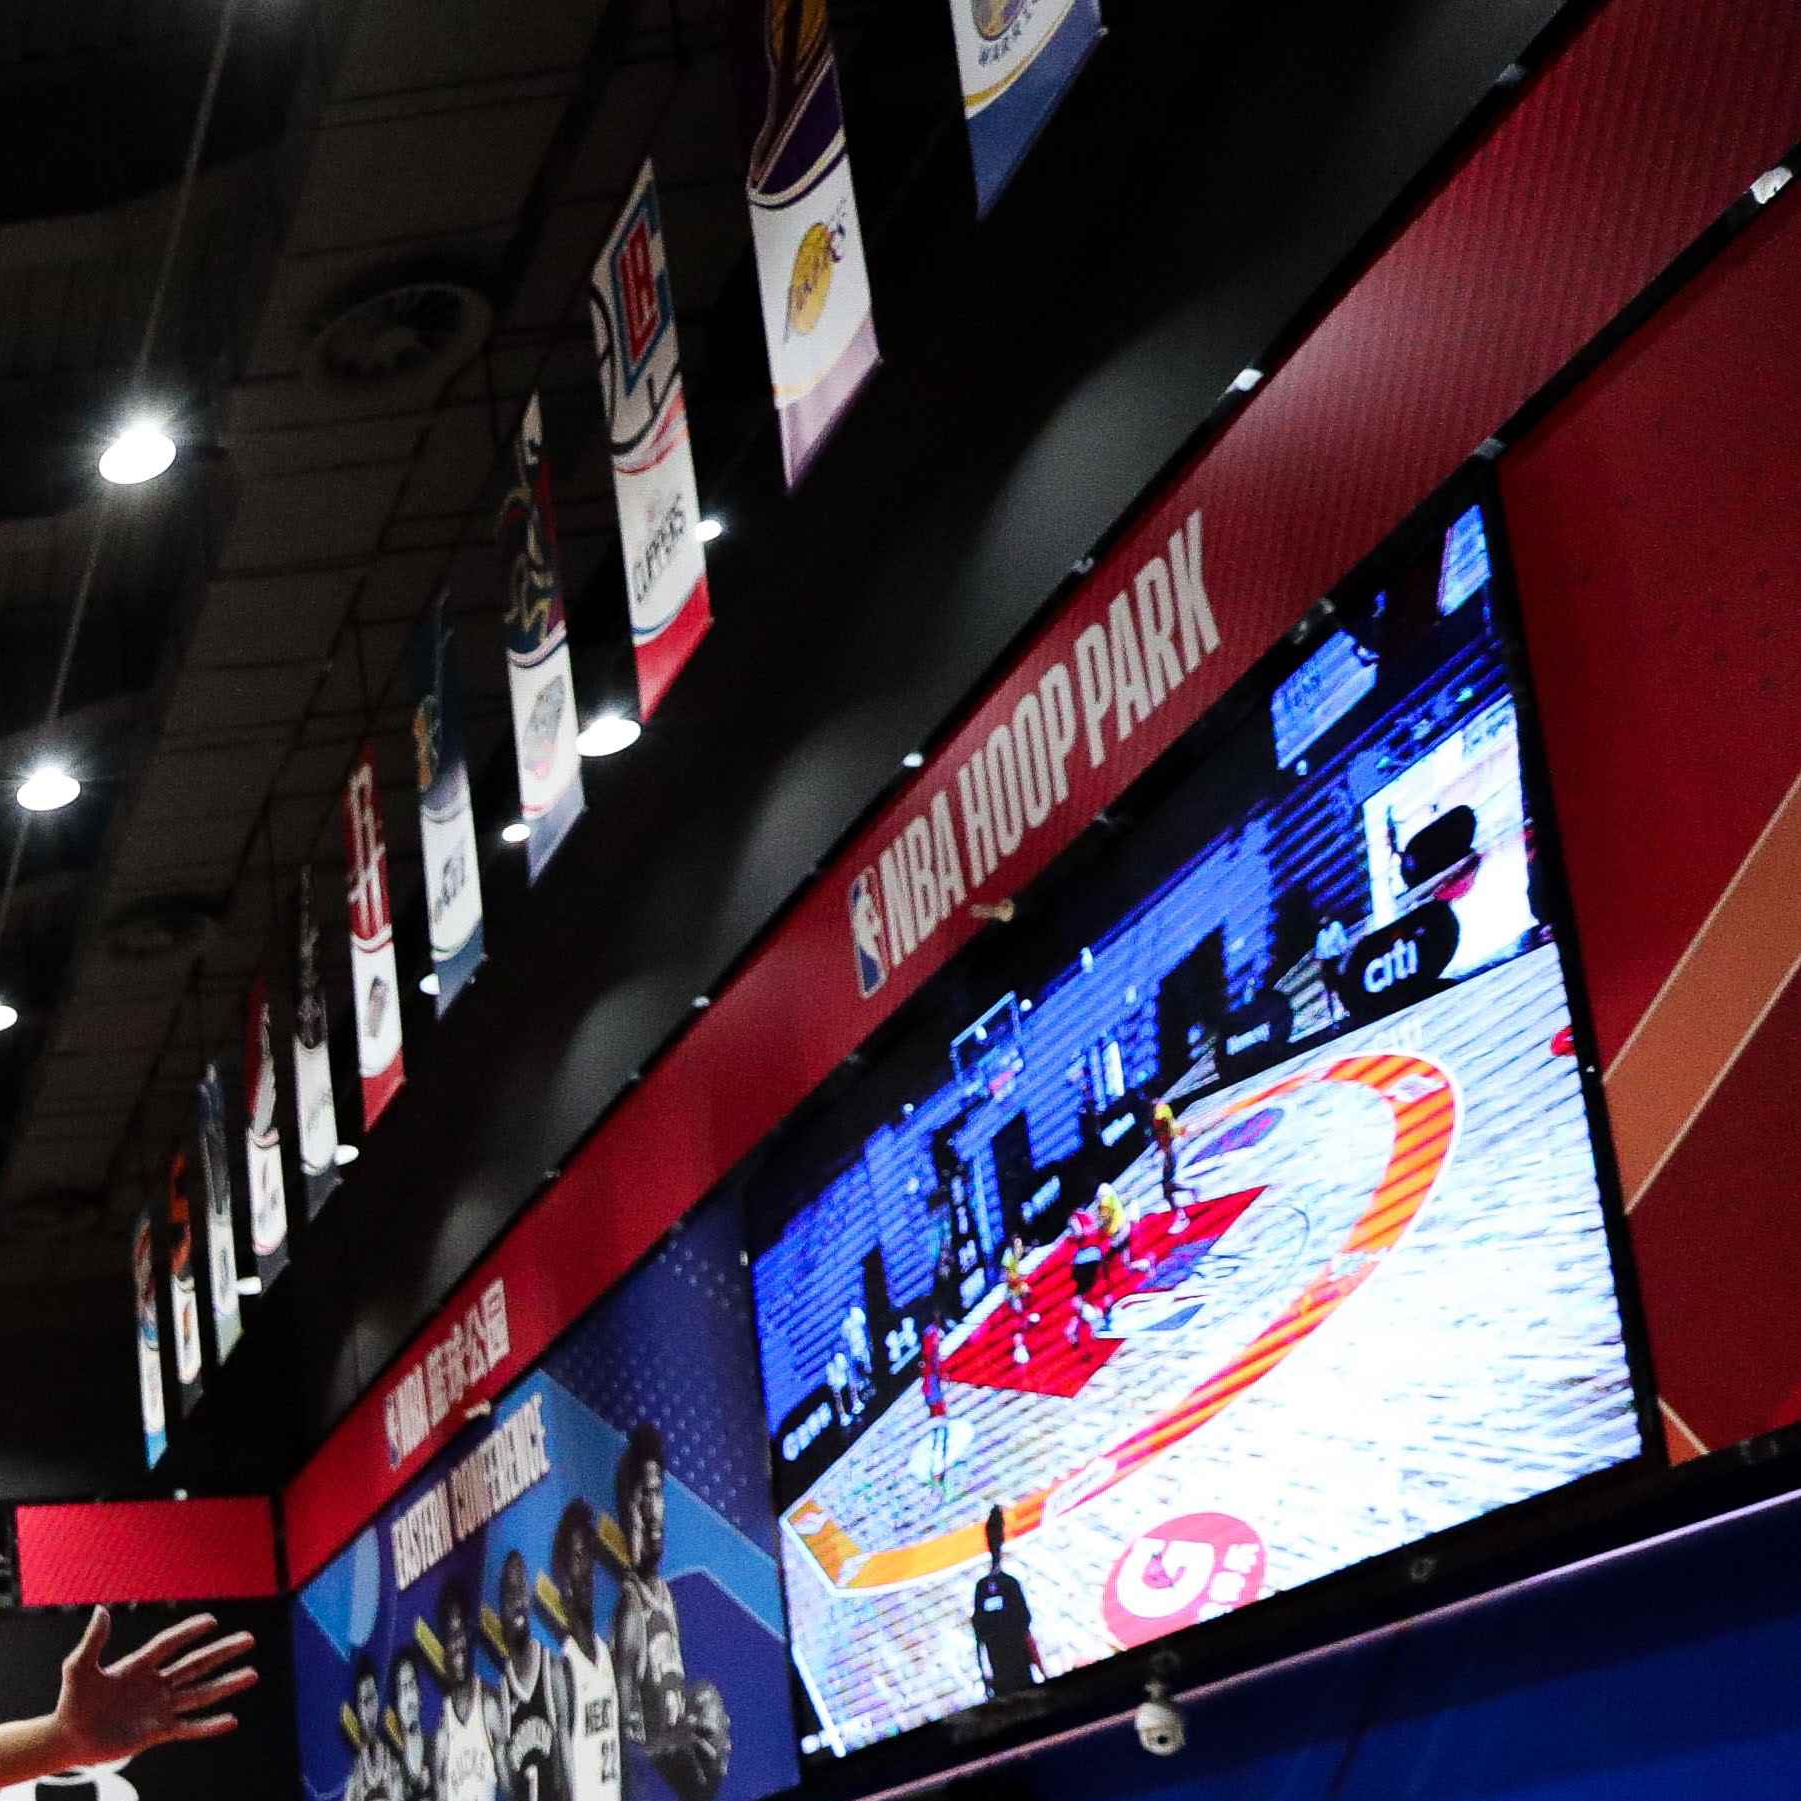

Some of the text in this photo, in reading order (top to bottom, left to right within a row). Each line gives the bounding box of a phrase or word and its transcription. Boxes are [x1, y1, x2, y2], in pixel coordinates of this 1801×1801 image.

[879, 509, 1222, 967] NBA HOOP PARK
[1364, 938, 1418, 993] citi
